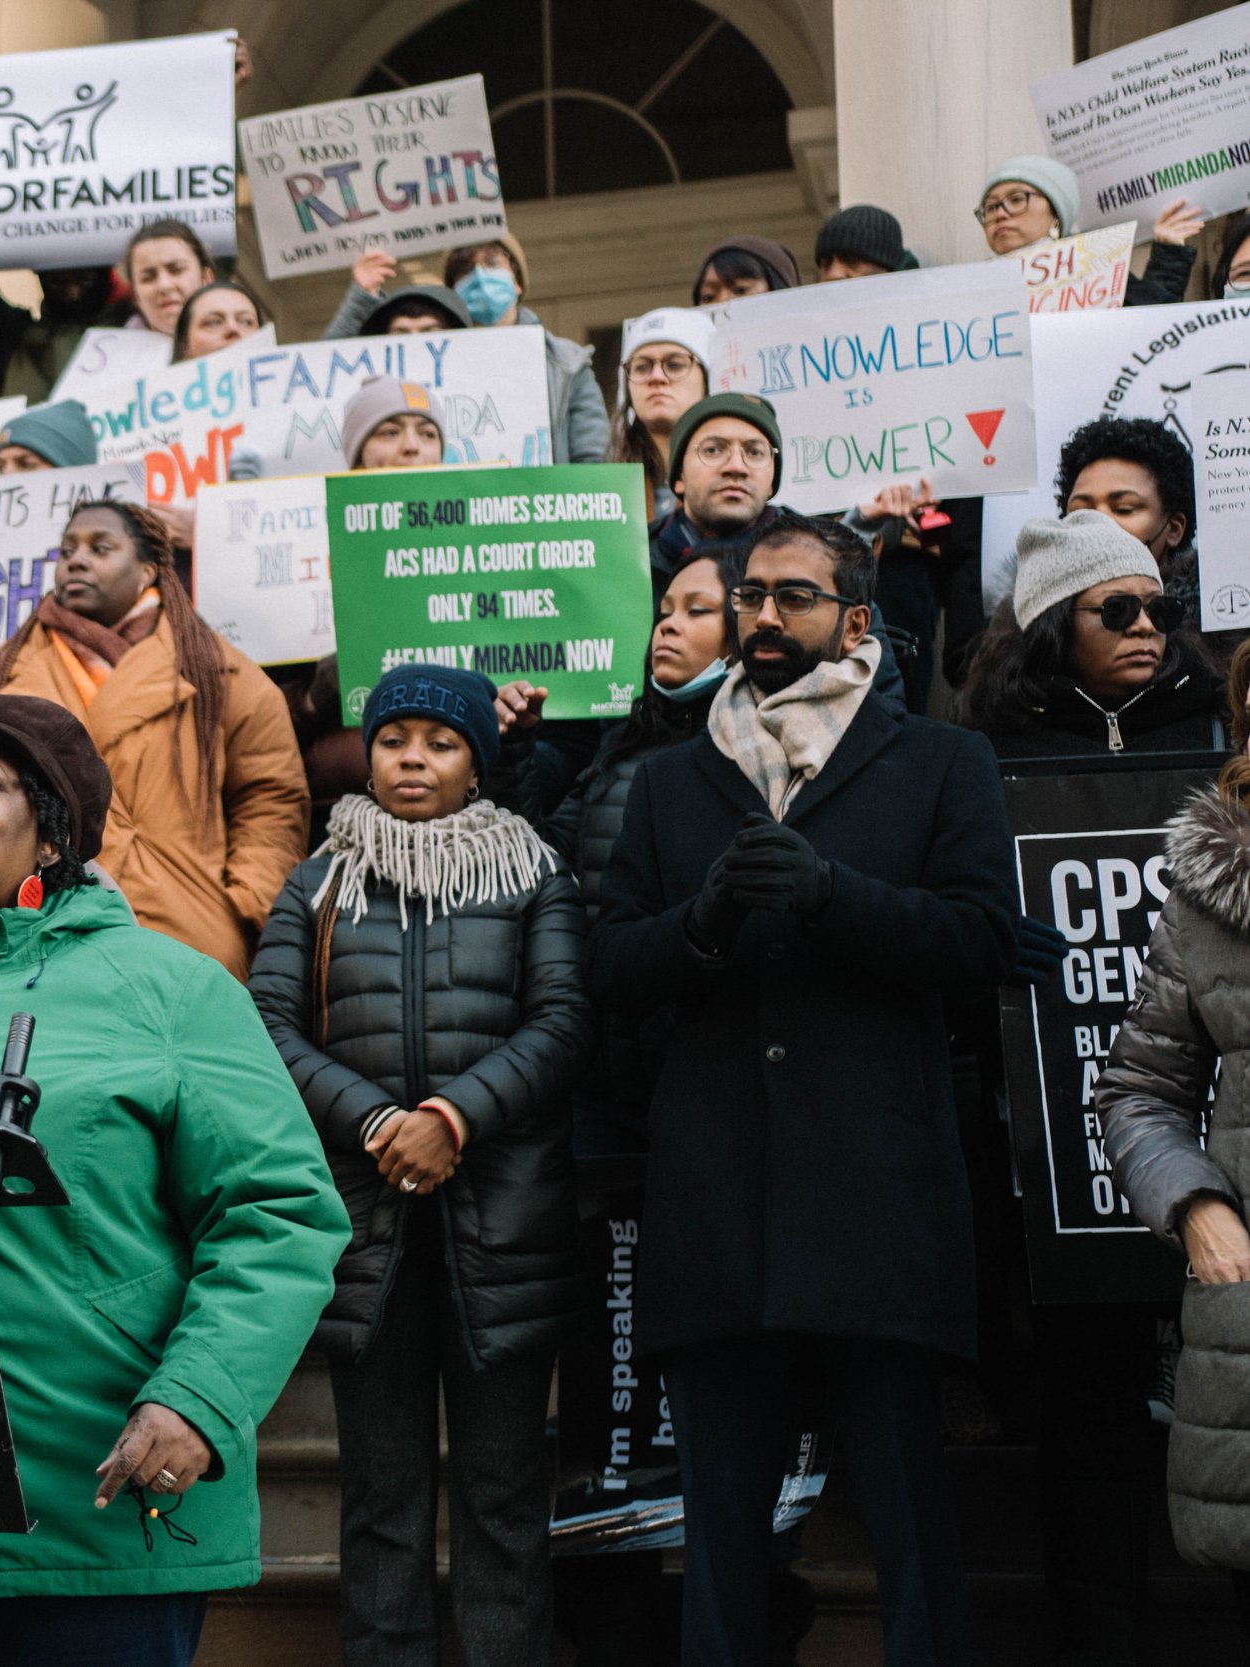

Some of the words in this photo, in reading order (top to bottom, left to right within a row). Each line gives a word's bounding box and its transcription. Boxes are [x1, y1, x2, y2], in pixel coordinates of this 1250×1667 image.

[1088, 88, 1119, 111] Child
[1121, 74, 1169, 98] Welfare
[1171, 58, 1217, 80] System
[1219, 42, 1250, 64] Raci
[244, 107, 355, 153] FAMILIES
[365, 92, 458, 129] DESERVE
[1050, 125, 1081, 146] Some
[1083, 118, 1095, 132] of
[1096, 112, 1110, 128] Its
[1113, 104, 1141, 121] Own
[1144, 84, 1196, 109] Workers
[1198, 74, 1223, 92] Say
[1226, 65, 1250, 80] Yes.
[255, 151, 286, 177] TO
[300, 143, 359, 165] KNOW
[1096, 140, 1250, 214] #FAMILYMIRANDANO
[286, 150, 502, 234] RIGHTS
[2, 217, 90, 239] CHANGE
[95, 211, 135, 232] FOR
[1022, 244, 1074, 287] SH
[758, 310, 1023, 394] KNOWLEDGE
[1131, 306, 1250, 365] Legislativ
[249, 338, 451, 407] FAMILY
[1102, 365, 1140, 413] rent
[88, 360, 238, 442] owledg
[843, 386, 873, 410] IS
[1205, 420, 1221, 437] Is
[1207, 468, 1232, 481] New
[1235, 466, 1250, 478] Yo
[1208, 484, 1245, 499] protect
[226, 499, 319, 543] FAMI
[344, 502, 379, 533] OUT
[381, 501, 404, 531] OF
[406, 498, 466, 531] 56,400
[468, 494, 531, 526] HOMES
[533, 491, 628, 525] SEARCHED,
[1208, 500, 1247, 513] agency
[384, 548, 420, 578] ACS
[422, 545, 460, 576] HAD
[462, 544, 477, 574] A
[478, 541, 536, 572] COURT
[538, 539, 596, 570] ORDER
[427, 591, 474, 623] ONLY
[477, 591, 498, 620] 94
[500, 588, 560, 620] TIMES.
[1062, 945, 1152, 1006] GEN
[606, 1218, 639, 1413] speaking
[601, 1427, 631, 1491] I'm
